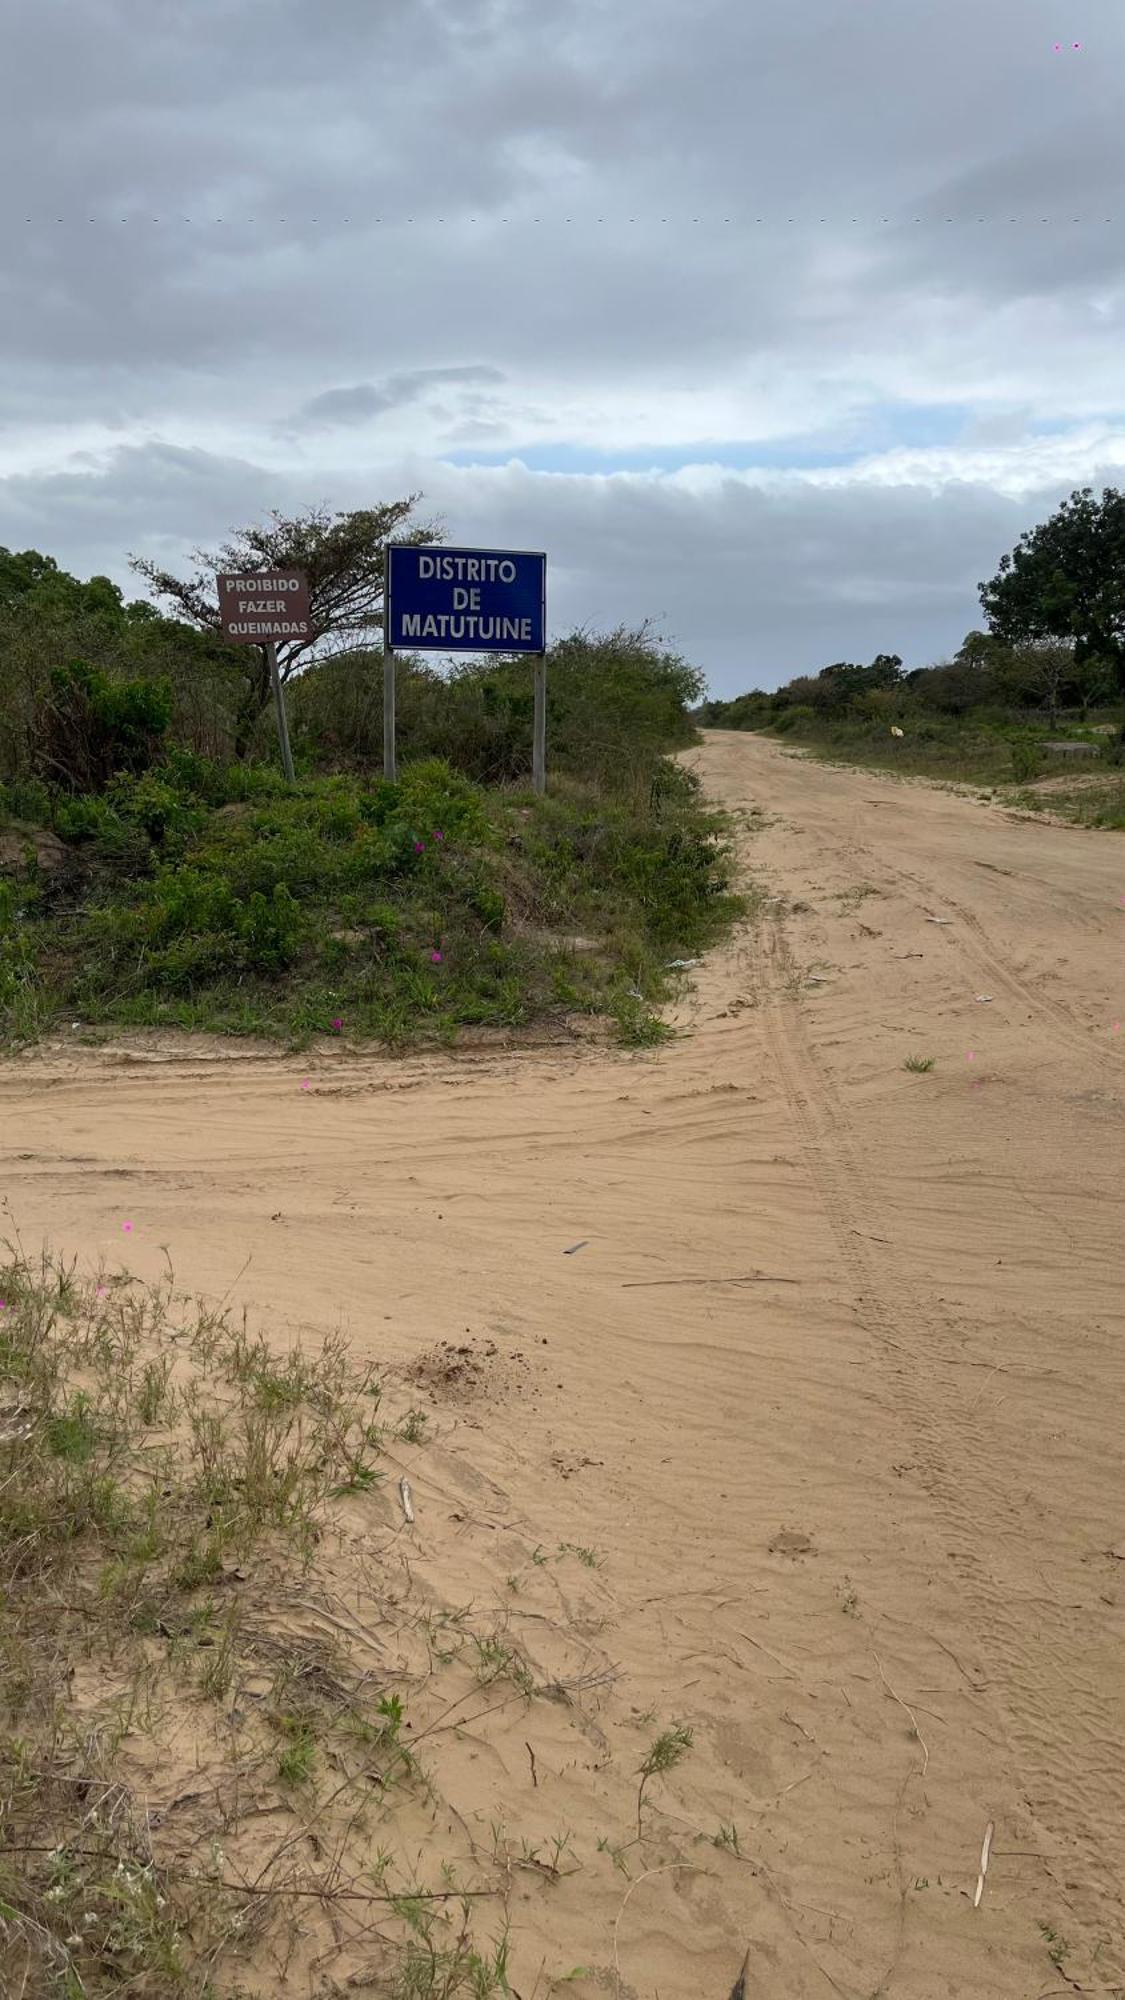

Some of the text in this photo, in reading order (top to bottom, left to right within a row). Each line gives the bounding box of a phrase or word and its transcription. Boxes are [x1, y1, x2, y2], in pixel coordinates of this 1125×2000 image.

[419, 556, 516, 583] DISTRITO
[226, 579, 299, 592] PROIBIDO
[238, 600, 287, 613] FAZER
[453, 587, 480, 610] DE
[228, 622, 308, 635] QUEIMADAS
[402, 614, 532, 640] MATUTUINE
